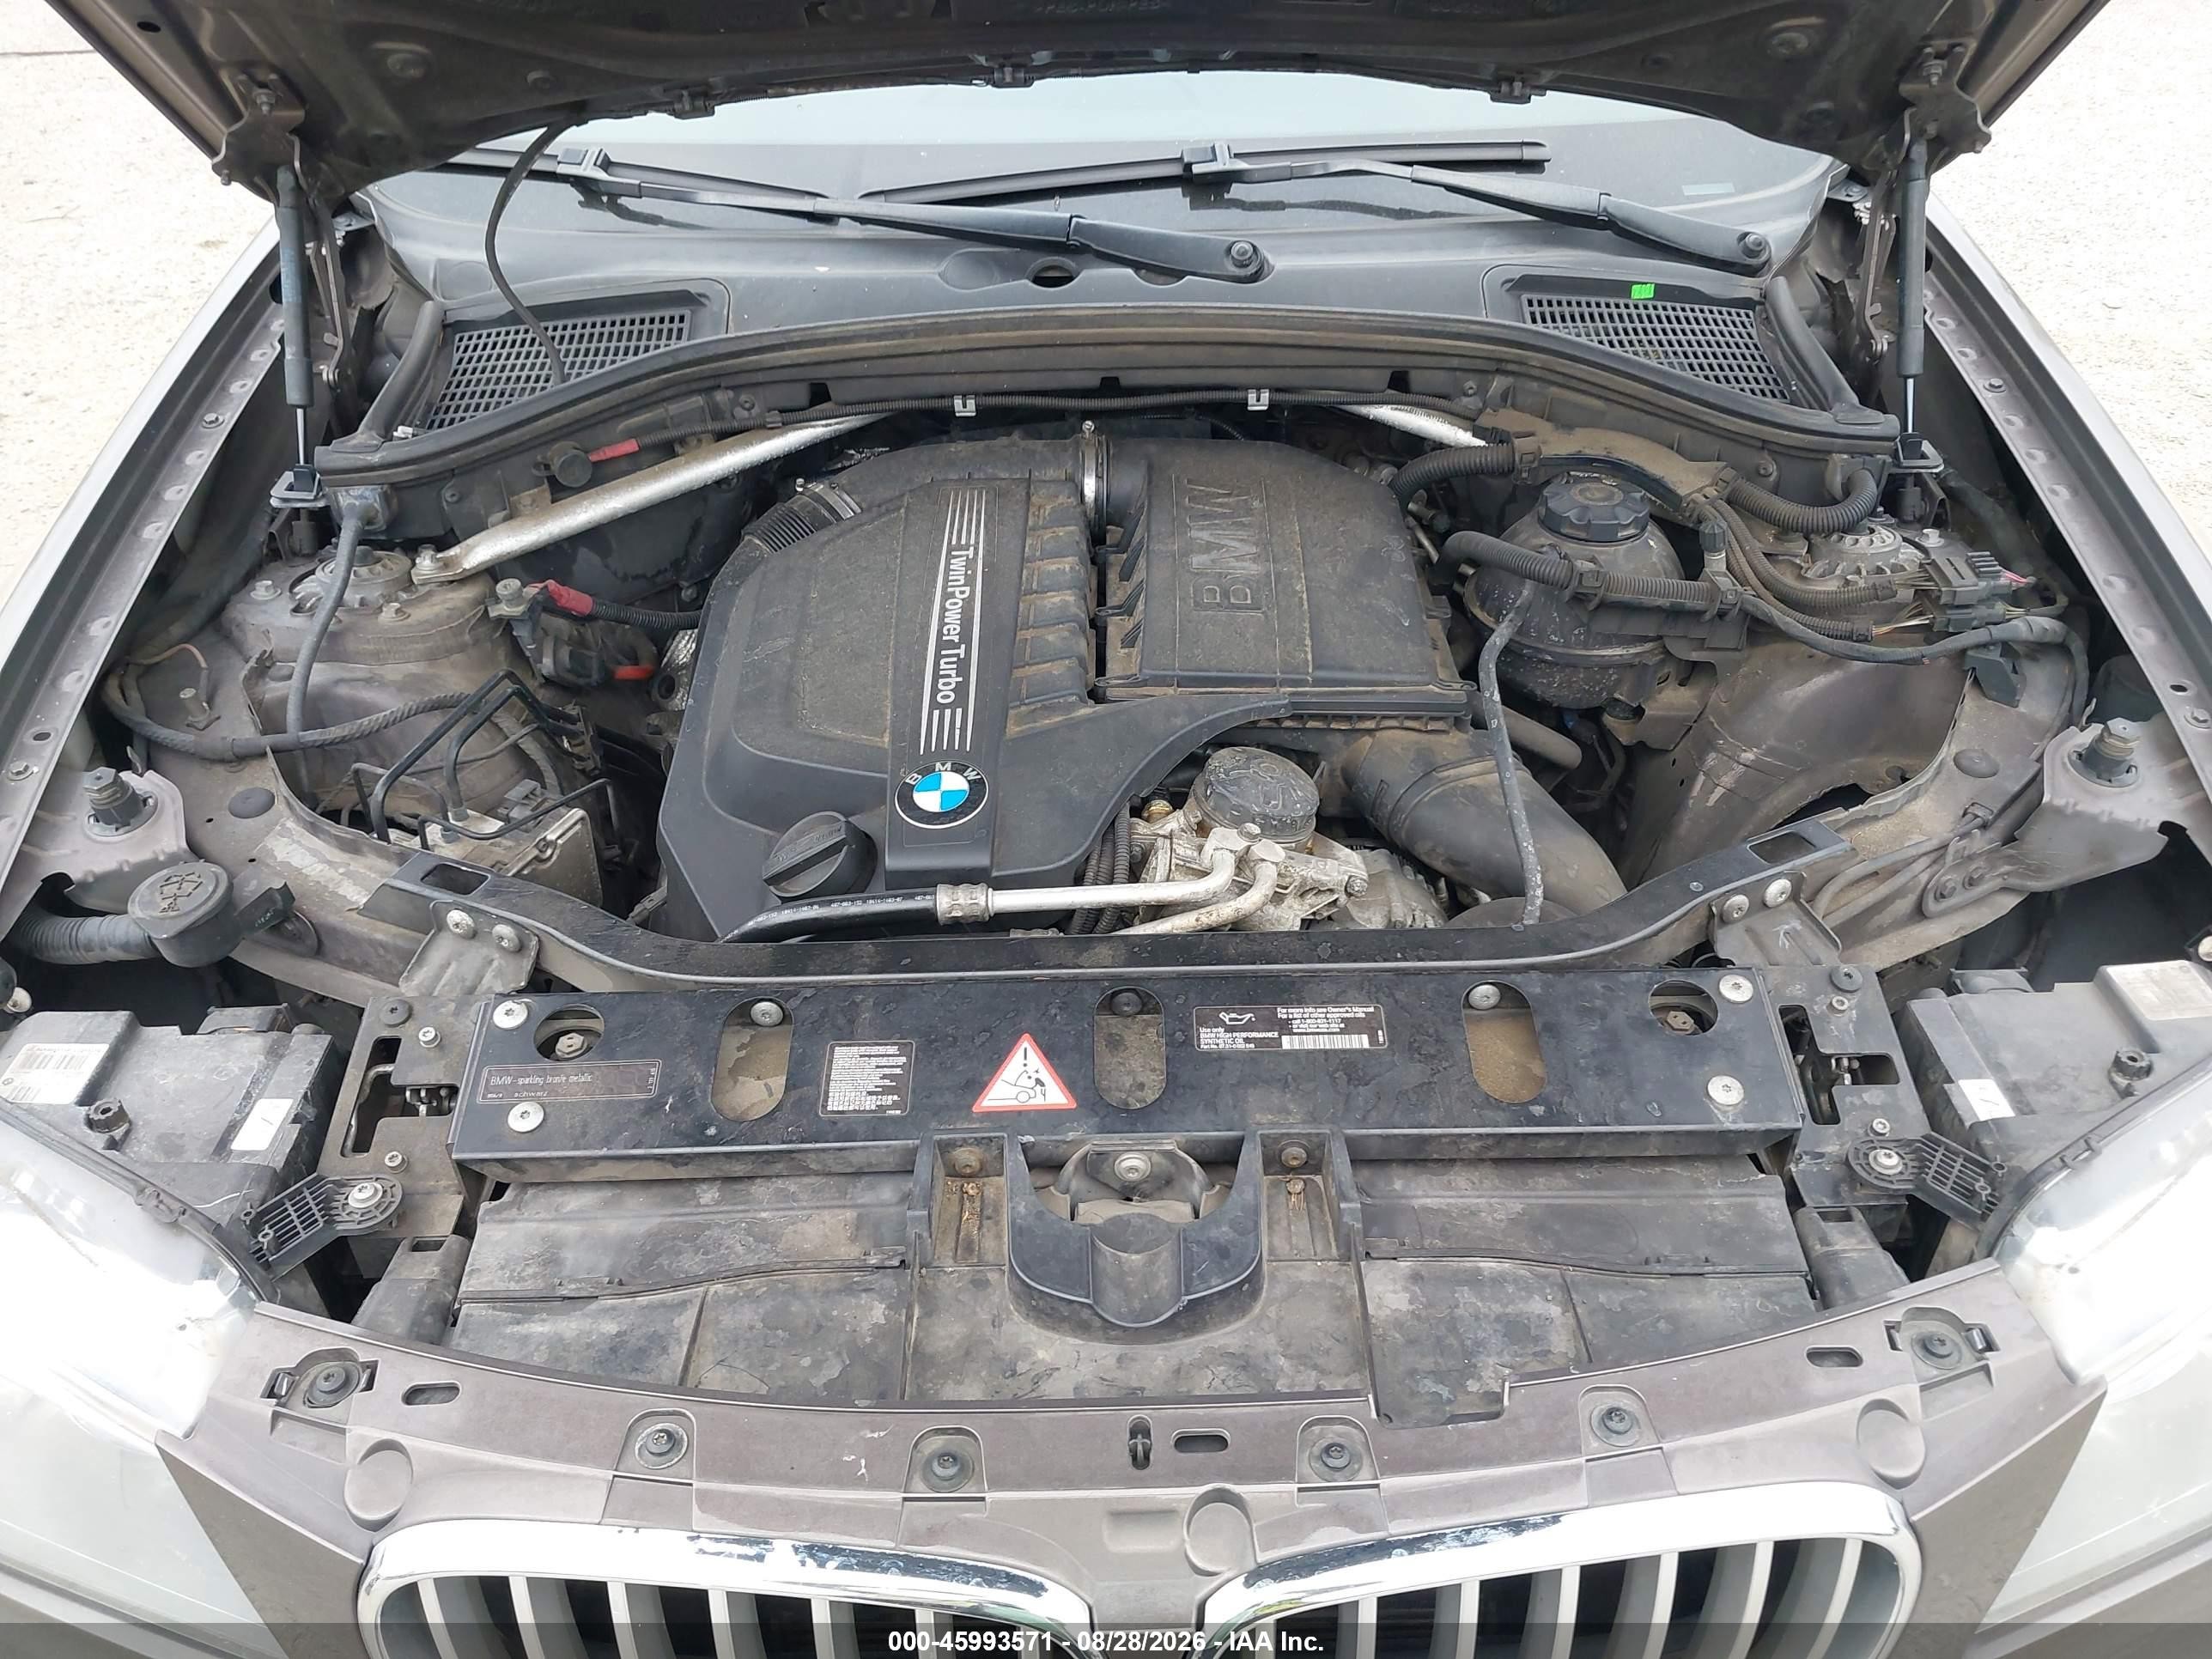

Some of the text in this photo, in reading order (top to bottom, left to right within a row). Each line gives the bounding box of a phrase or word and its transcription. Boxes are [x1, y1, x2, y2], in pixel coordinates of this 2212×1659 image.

[1185, 477, 1266, 617] BMW
[936, 546, 974, 705] TwinPower Turbo
[904, 762, 982, 786] BMW
